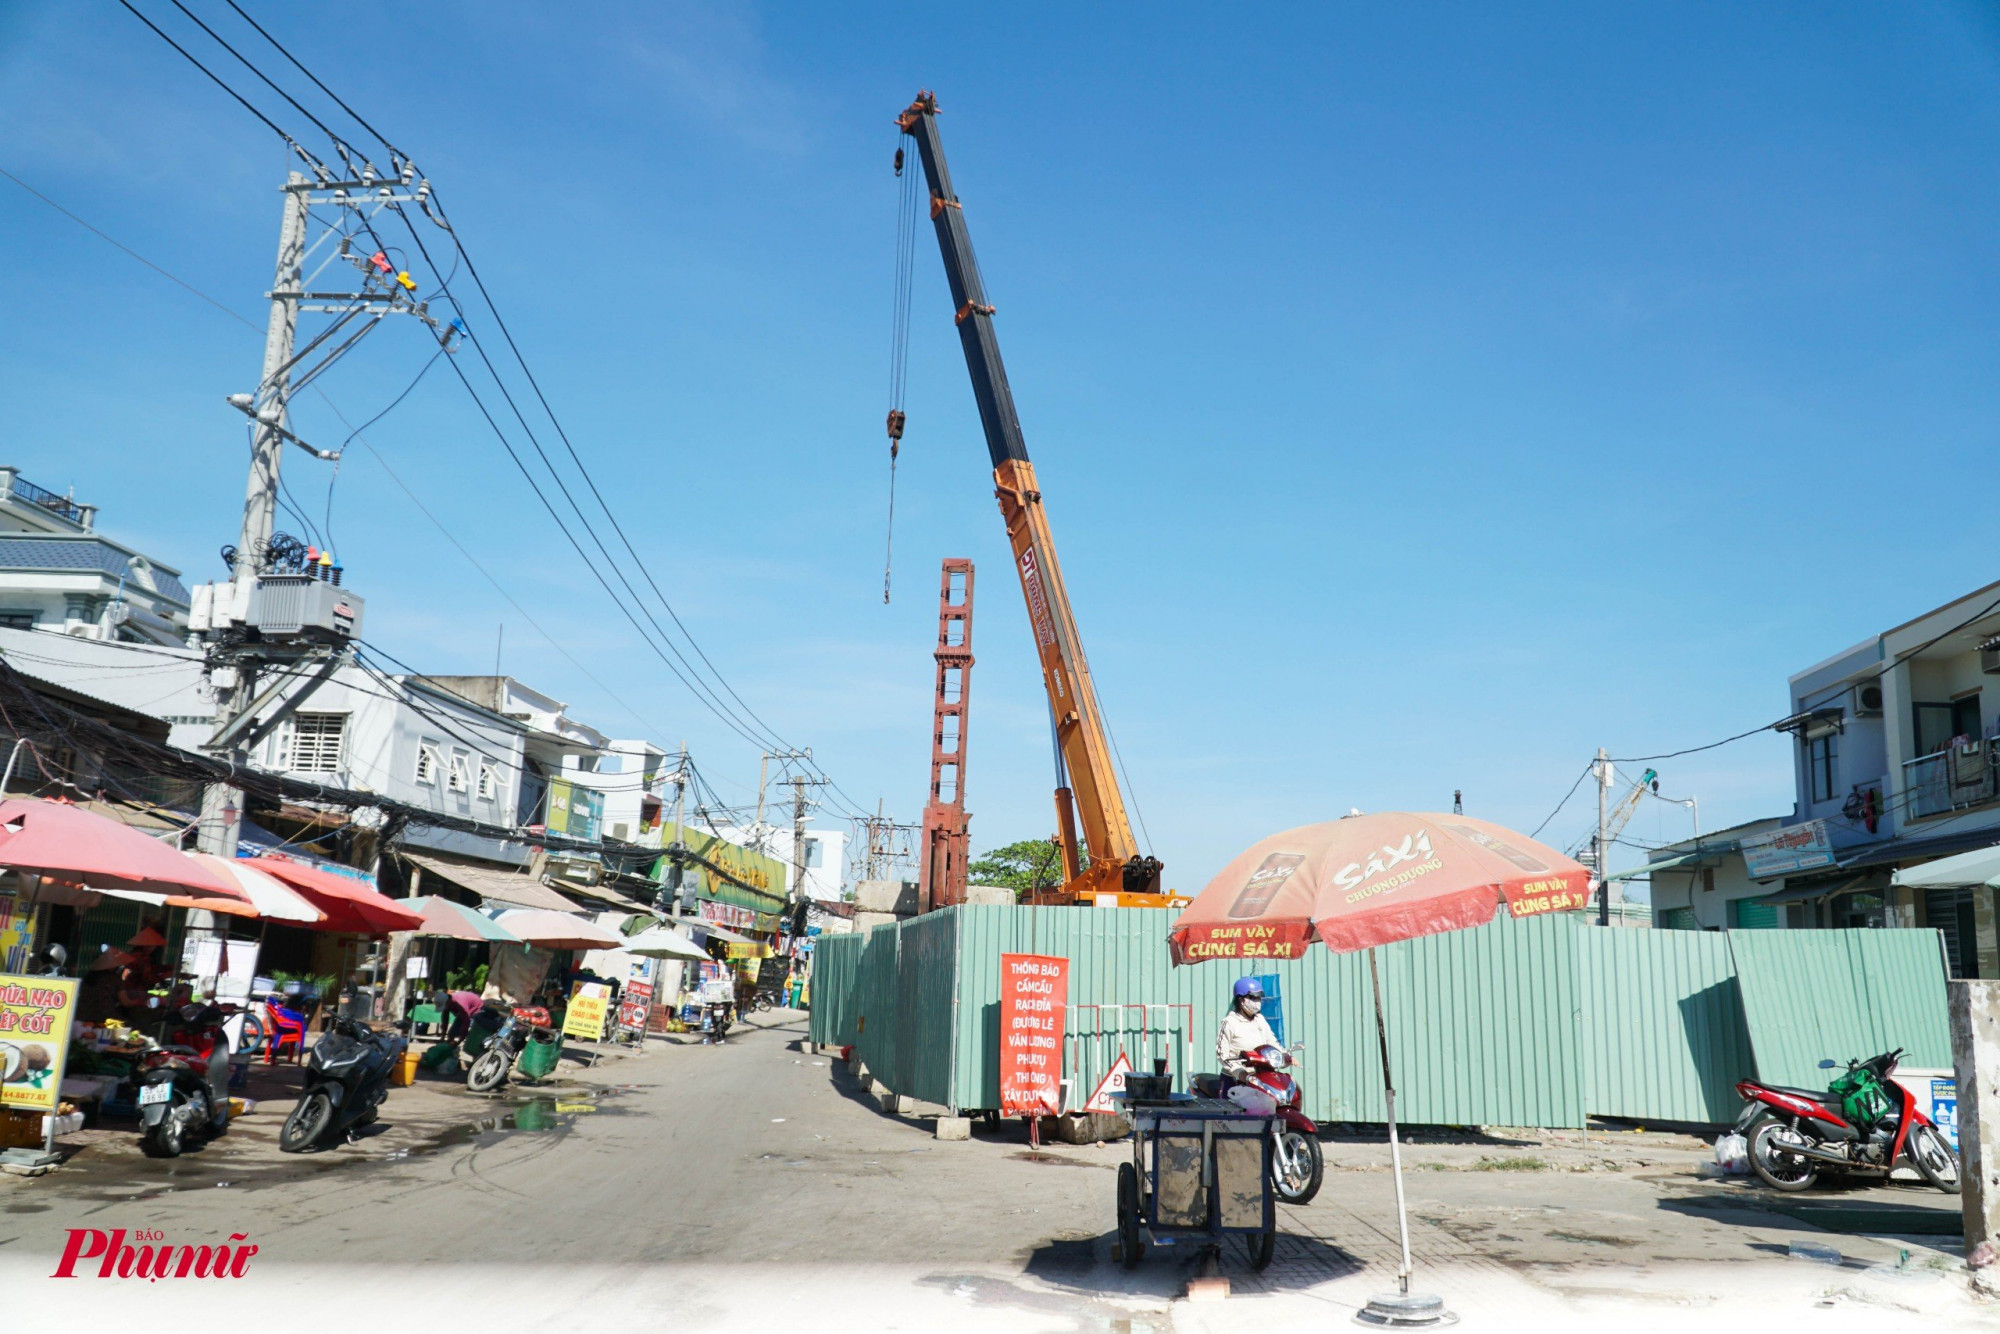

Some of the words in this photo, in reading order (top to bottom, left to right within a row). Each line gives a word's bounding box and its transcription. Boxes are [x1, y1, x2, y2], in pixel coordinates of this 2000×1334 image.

[1523, 880, 1548, 895] SUM
[1512, 898, 1551, 915] CÙNG
[1551, 891, 1572, 908] SÁ
[1211, 927, 1241, 939] SUM
[1188, 941, 1236, 957] CÙNG
[1243, 940, 1269, 956] SÁ
[1010, 961, 1040, 975] THÔNG
[1041, 962, 1060, 977] BÁO
[1041, 1016, 1054, 1031] LÊ
[1008, 1033, 1028, 1047] VĂN
[1030, 1071, 1046, 1084] ÔNG
[1003, 1087, 1021, 1102] XÂY
